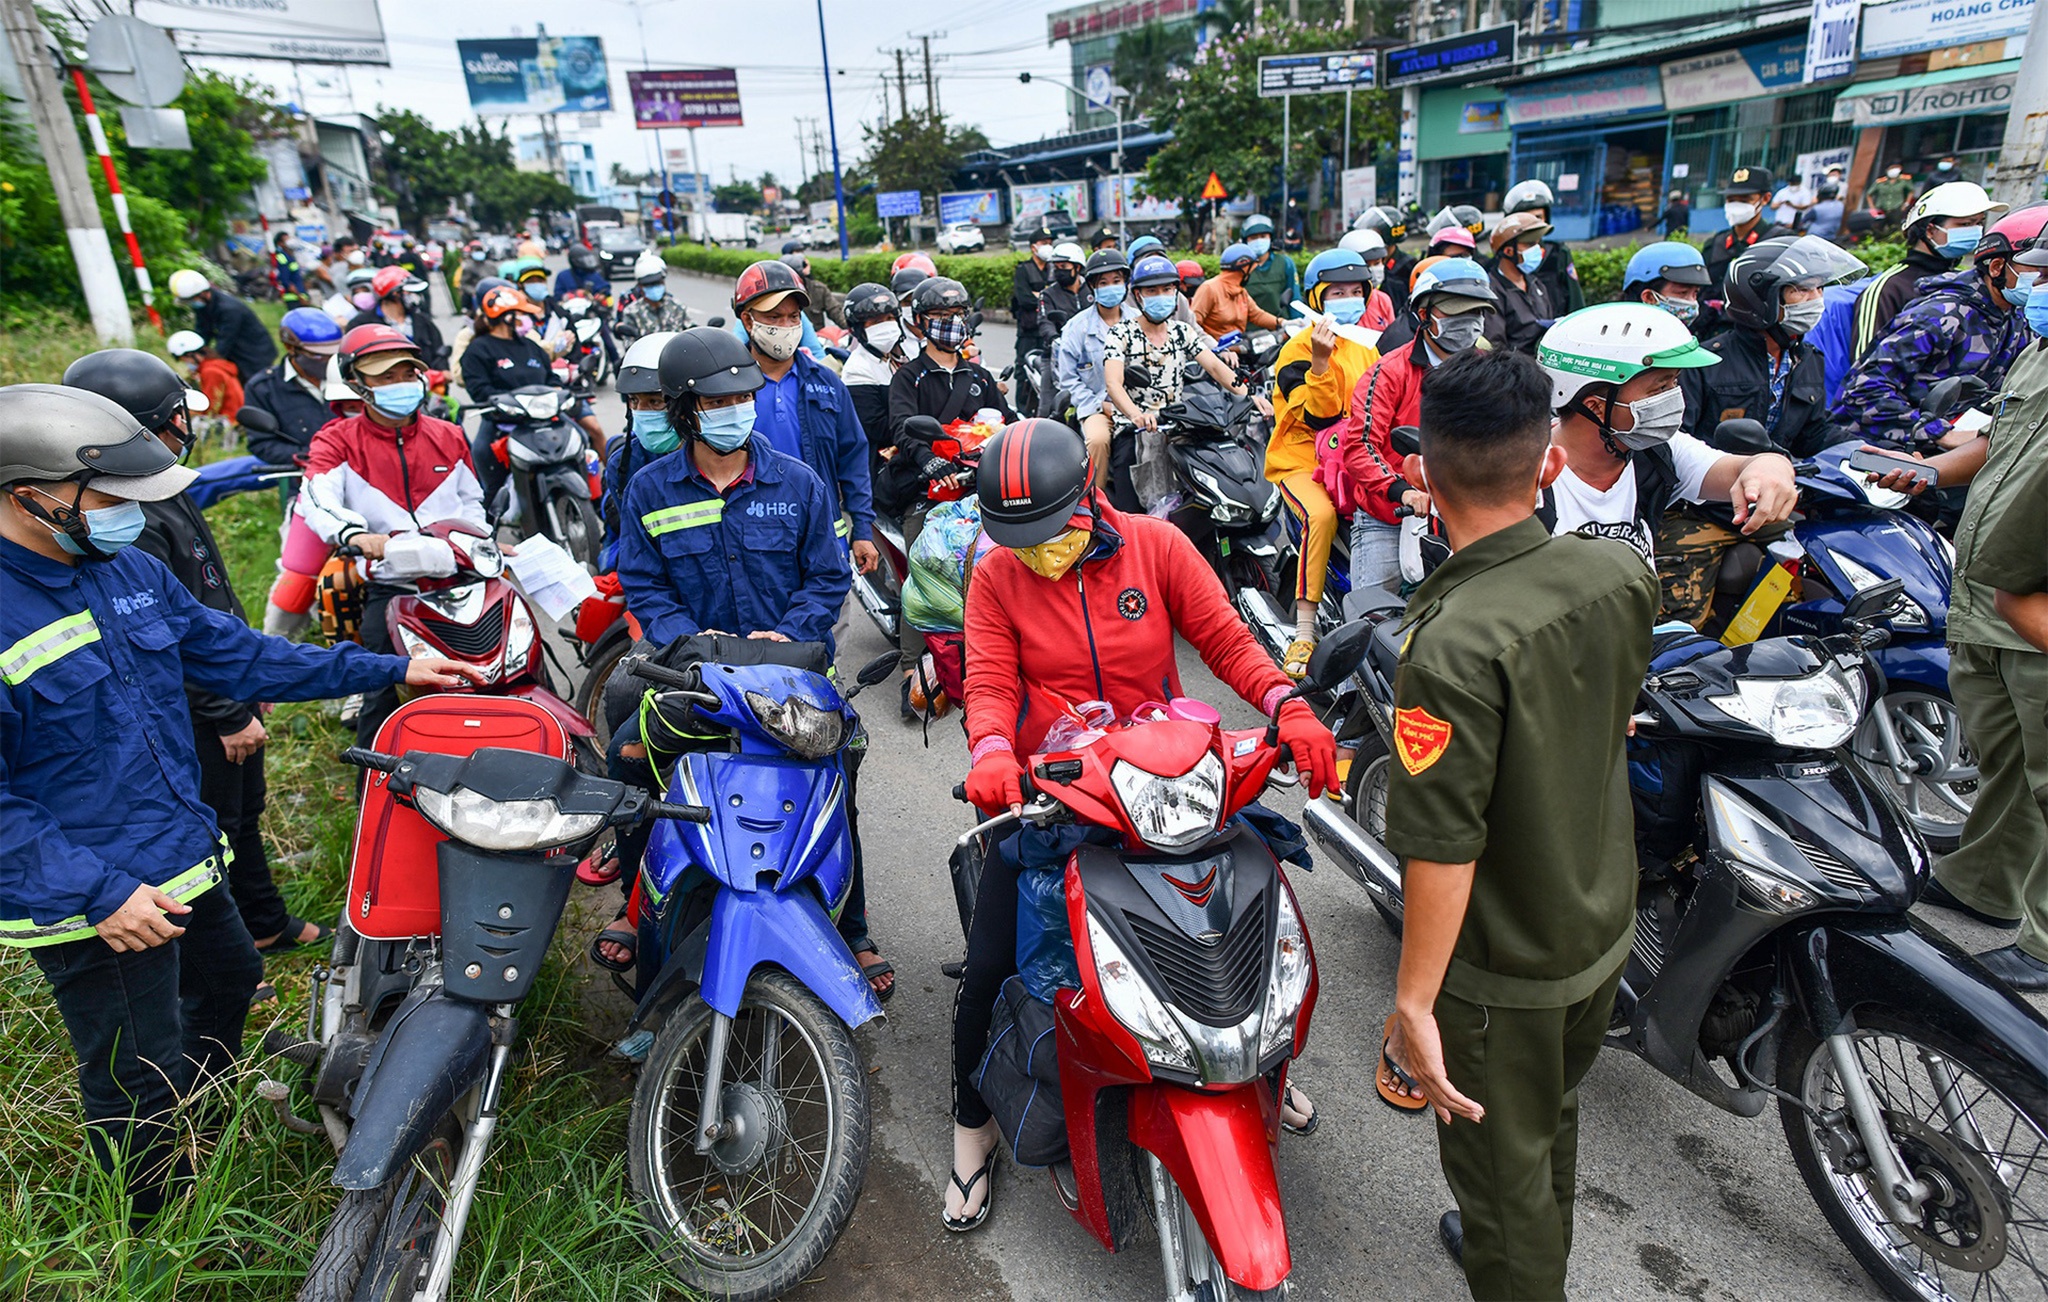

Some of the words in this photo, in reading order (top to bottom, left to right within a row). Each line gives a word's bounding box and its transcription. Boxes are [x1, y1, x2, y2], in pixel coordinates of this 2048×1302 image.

[1930, 2, 1992, 23] HOÀNG
[766, 502, 798, 517] HBC
[1009, 497, 1032, 507] YAMAHA
[1787, 615, 1819, 631] HONDA
